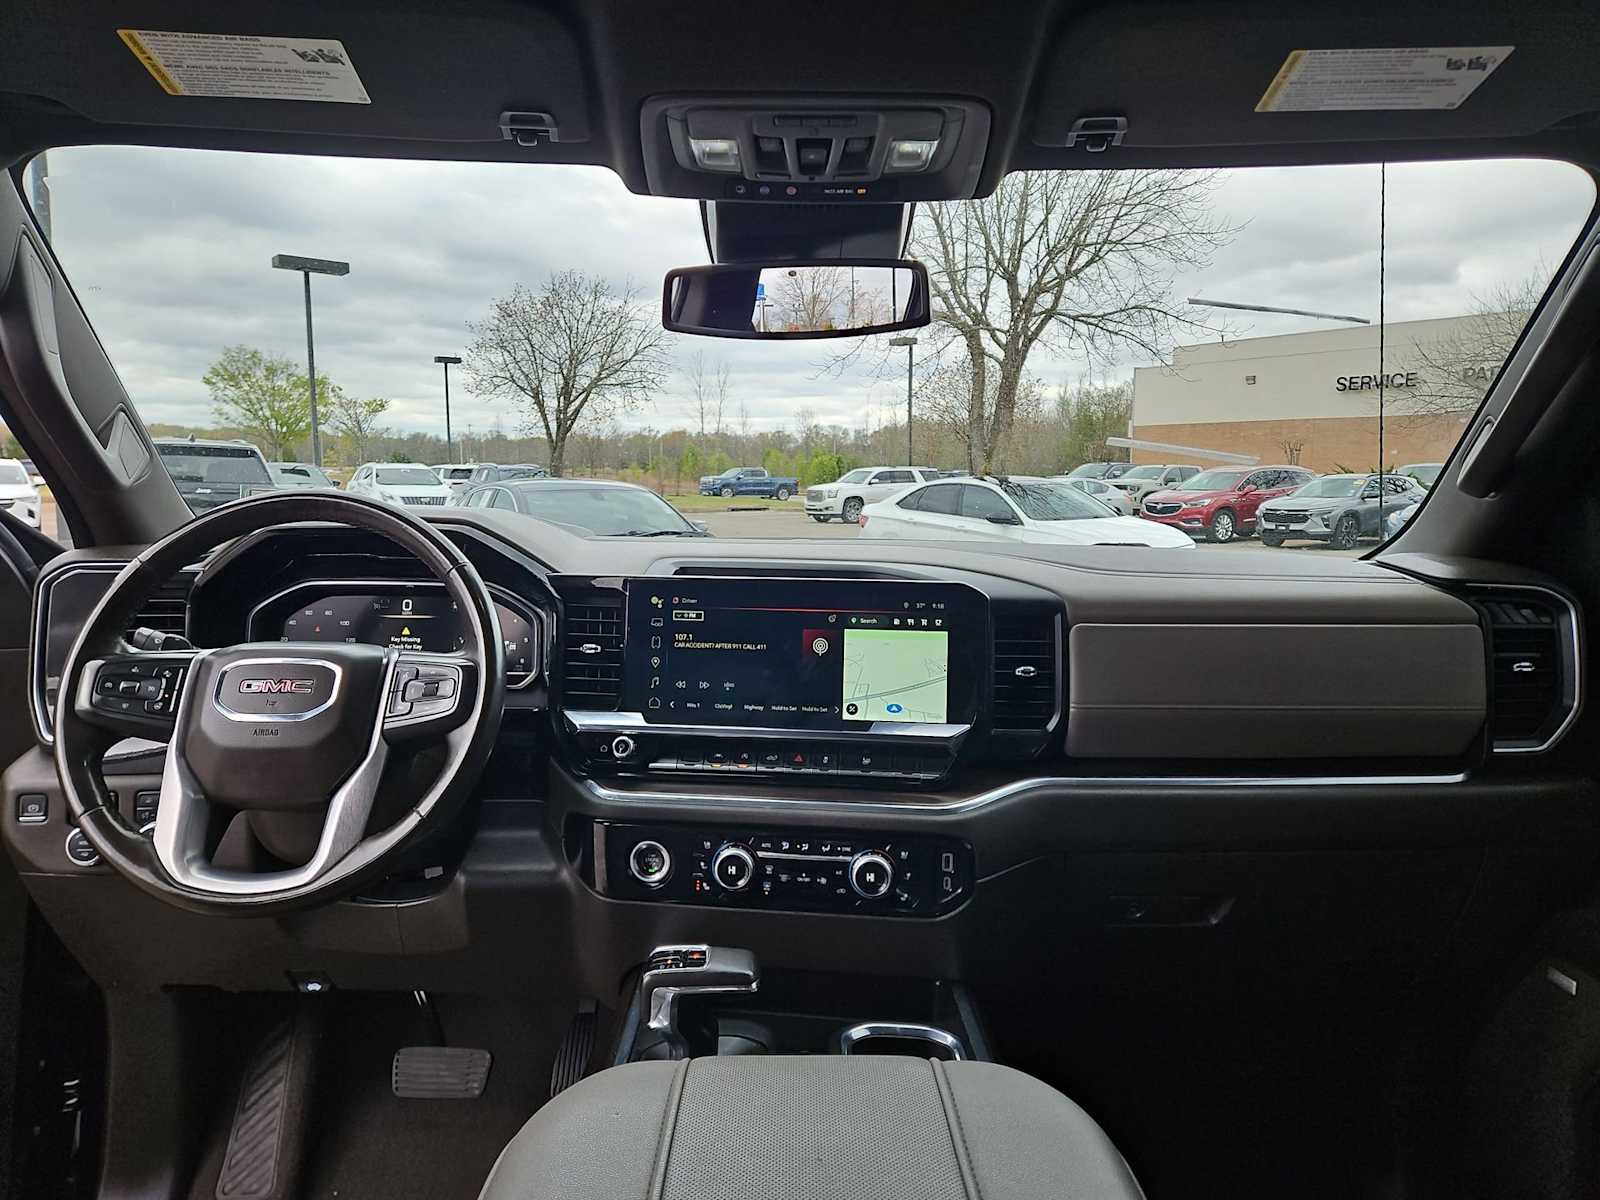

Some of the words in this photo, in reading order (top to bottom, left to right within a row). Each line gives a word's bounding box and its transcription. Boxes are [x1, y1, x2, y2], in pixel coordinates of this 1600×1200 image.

[1336, 373, 1417, 392] SERVICE
[402, 599, 412, 611] 0
[675, 633, 693, 641] 107.1
[239, 679, 314, 693] GMC
